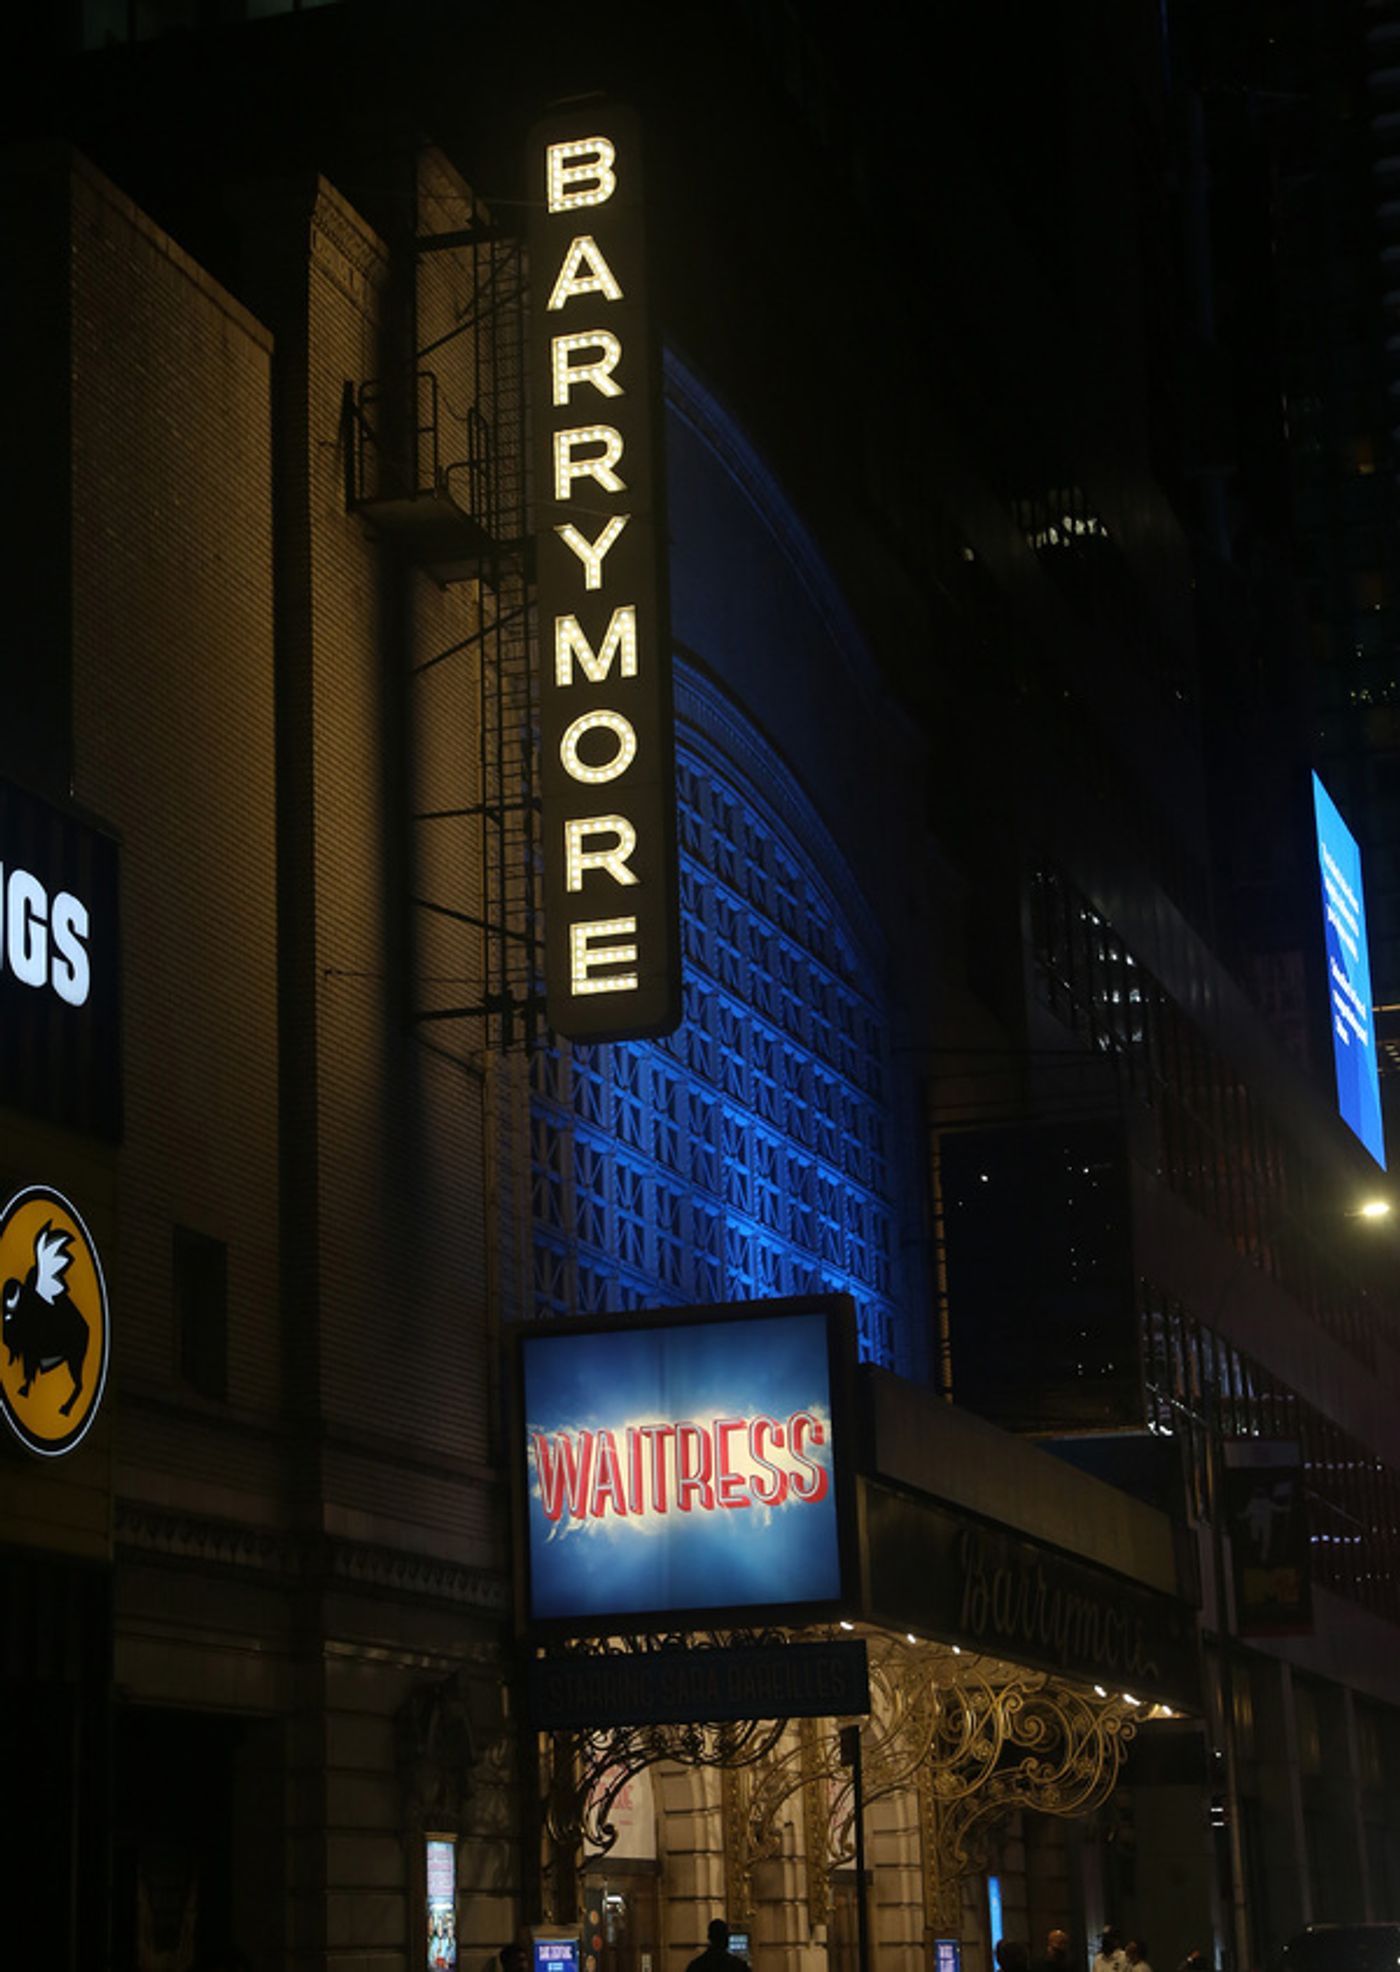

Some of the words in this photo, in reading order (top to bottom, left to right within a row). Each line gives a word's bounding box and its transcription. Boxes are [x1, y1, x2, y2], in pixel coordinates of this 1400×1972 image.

[545, 135, 639, 997] BARRYMORE
[0, 861, 90, 1007] GS
[532, 1411, 829, 1522] WAITRESS
[549, 1669, 654, 1712] STARRING
[661, 1665, 718, 1706] SARA
[728, 1659, 847, 1702] BAREILLES
